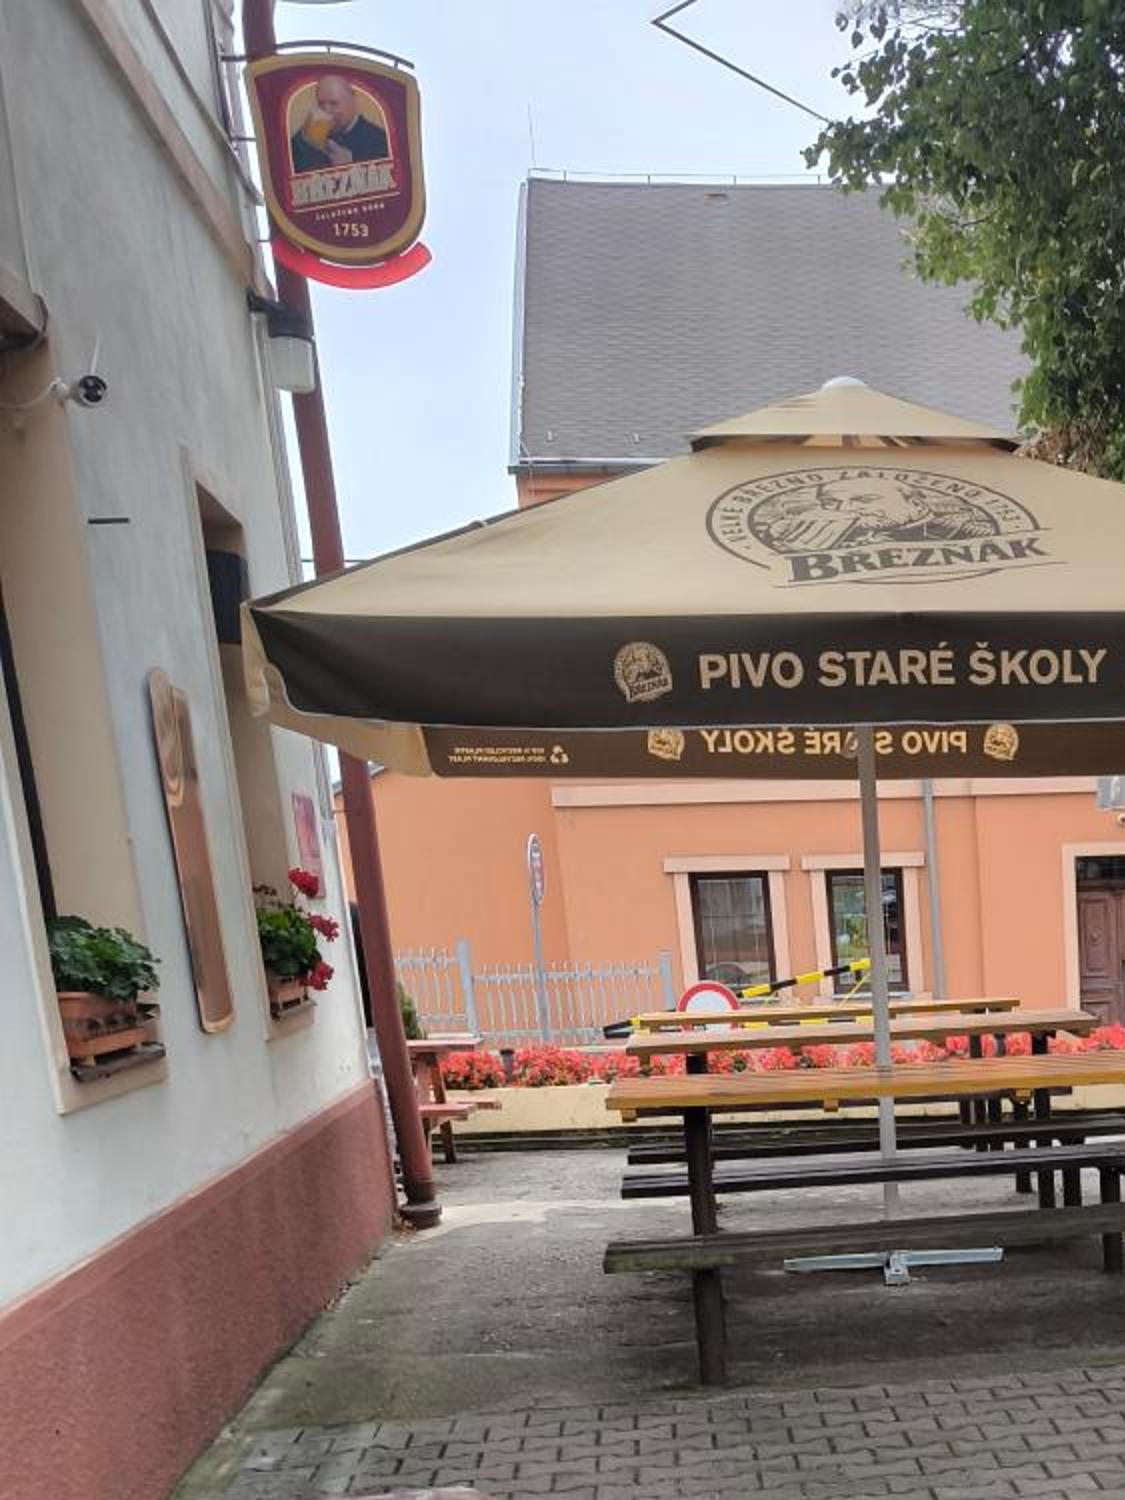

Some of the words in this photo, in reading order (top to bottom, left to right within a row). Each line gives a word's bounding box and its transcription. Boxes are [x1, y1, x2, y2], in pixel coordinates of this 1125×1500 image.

[333, 223, 369, 237] 1753
[699, 651, 804, 689] PIVO
[817, 642, 957, 687] STARÉ
[968, 641, 1107, 685] ŠKOLY
